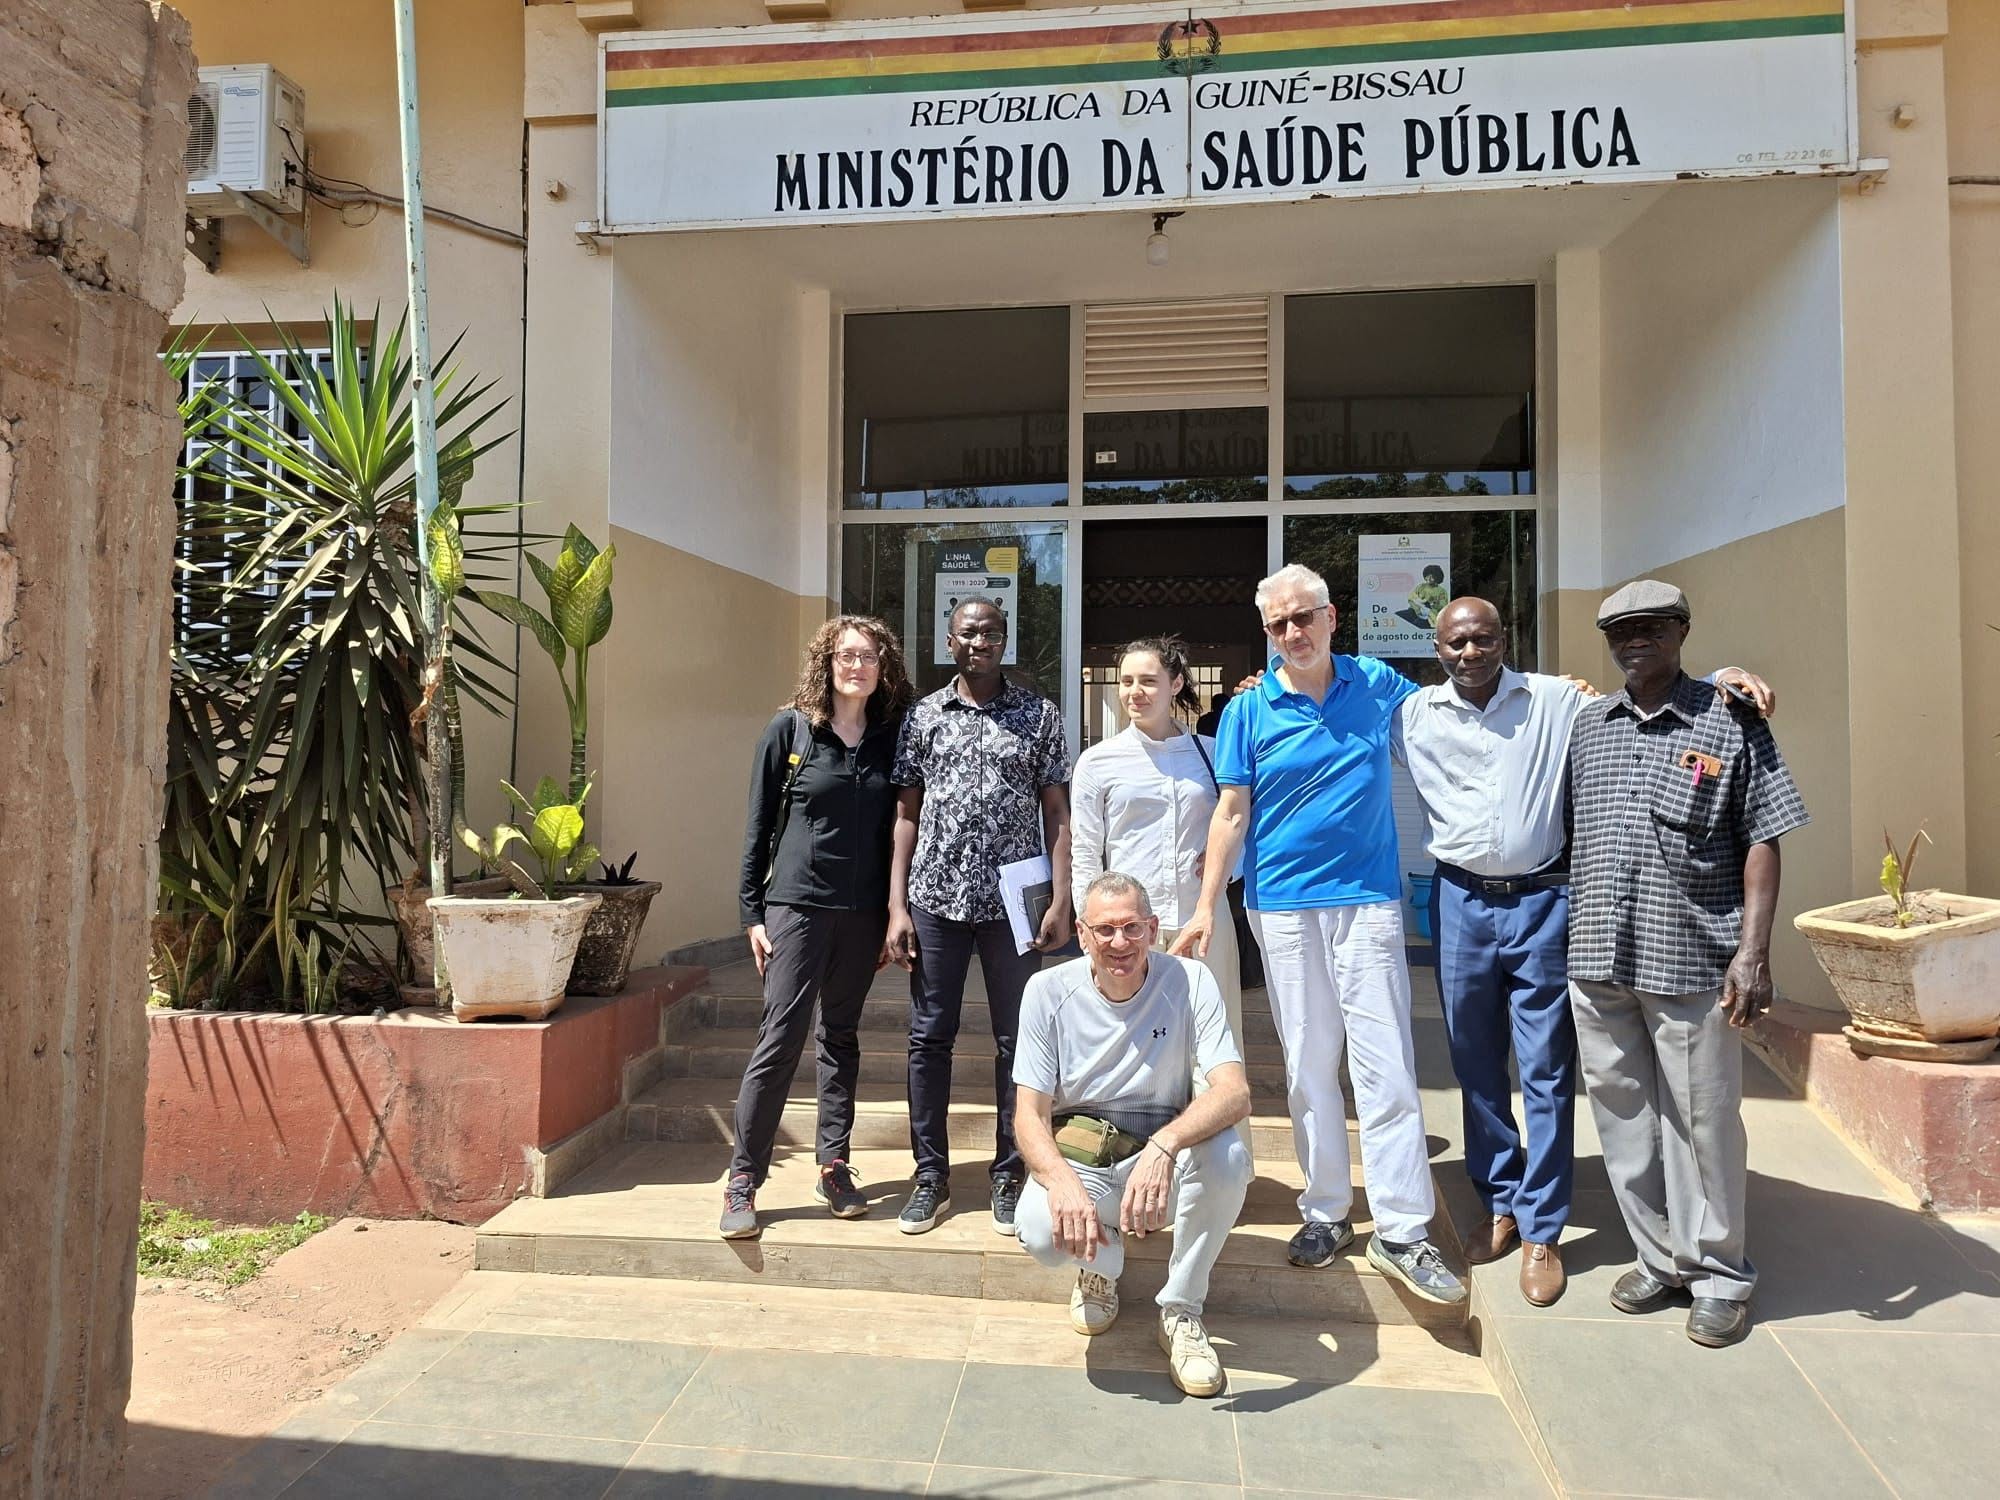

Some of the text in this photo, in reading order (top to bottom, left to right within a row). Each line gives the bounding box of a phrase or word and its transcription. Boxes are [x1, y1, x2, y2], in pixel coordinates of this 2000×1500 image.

[910, 67, 1464, 126] REPÚBLICA DA GUINÉ-BISSAU
[775, 104, 1640, 211] MINISTÉRIO DA SAÚDE PÚBLICA
[942, 560, 969, 569] SAÚDE
[1372, 604, 1388, 614] De
[1372, 616, 1379, 627] à
[1362, 633, 1374, 641] de
[1376, 633, 1409, 642] agosto
[1411, 632, 1424, 640] de
